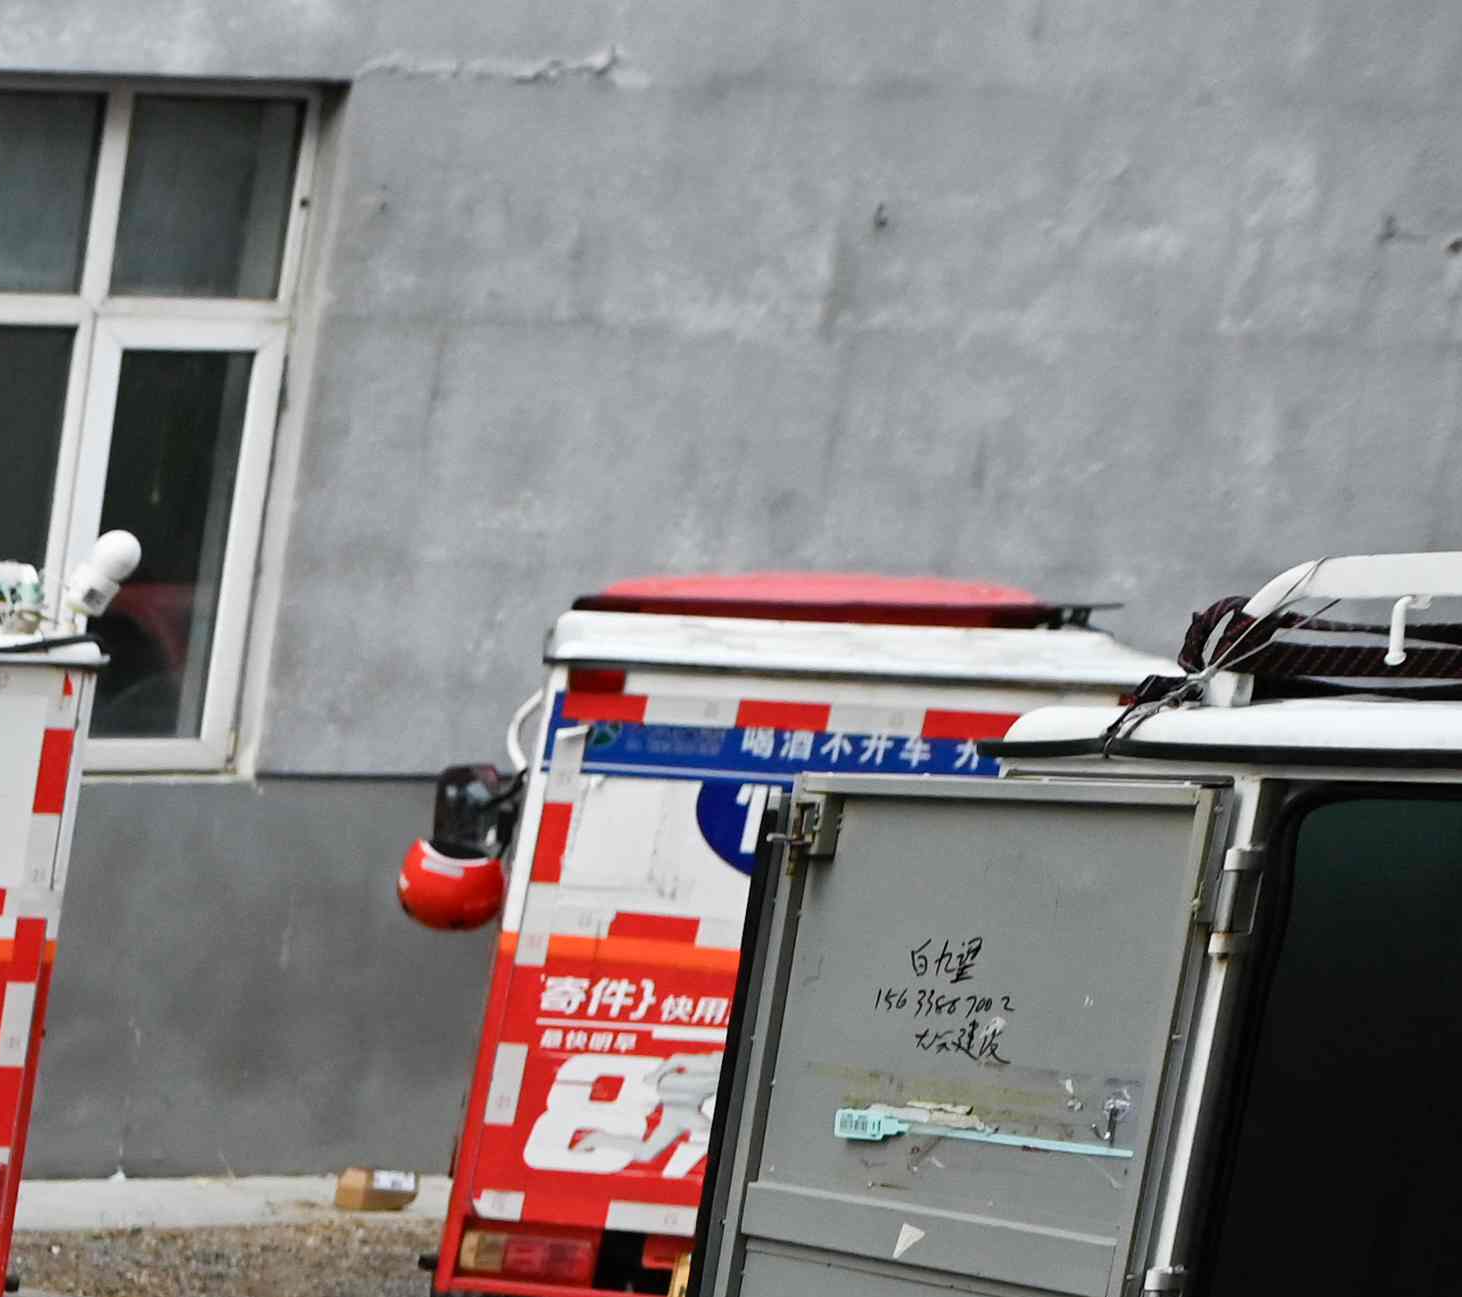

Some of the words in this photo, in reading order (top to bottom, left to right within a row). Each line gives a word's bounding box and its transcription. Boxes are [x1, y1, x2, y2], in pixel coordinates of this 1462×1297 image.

[741, 728, 933, 767] 喝酒不开车
[539, 1028, 637, 1053] 最快明早
